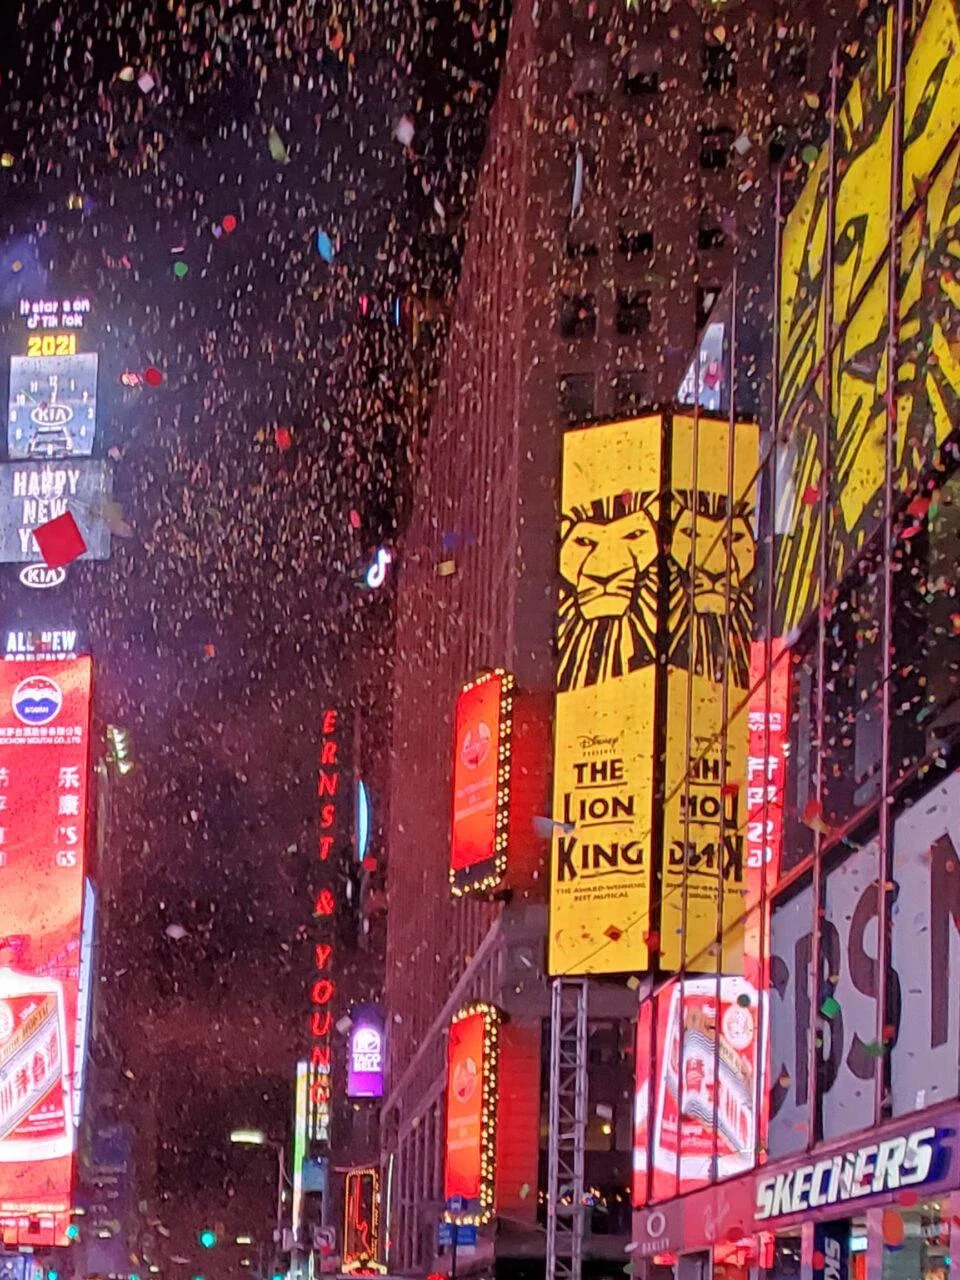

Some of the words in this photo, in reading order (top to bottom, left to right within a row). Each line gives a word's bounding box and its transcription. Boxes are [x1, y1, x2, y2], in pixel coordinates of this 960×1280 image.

[26, 334, 77, 357] 2021
[38, 407, 67, 421] KIA
[13, 470, 80, 496] HAPPY
[23, 498, 68, 524] NEW
[27, 569, 58, 583] KIA
[573, 758, 624, 784] THE
[316, 709, 340, 860] ERNST
[564, 793, 635, 827] LION
[557, 836, 644, 882] KING
[316, 888, 336, 916] &
[352, 1053, 381, 1063] TACO
[353, 1062, 382, 1072] BELL
[754, 1127, 937, 1221] SKECHERS
